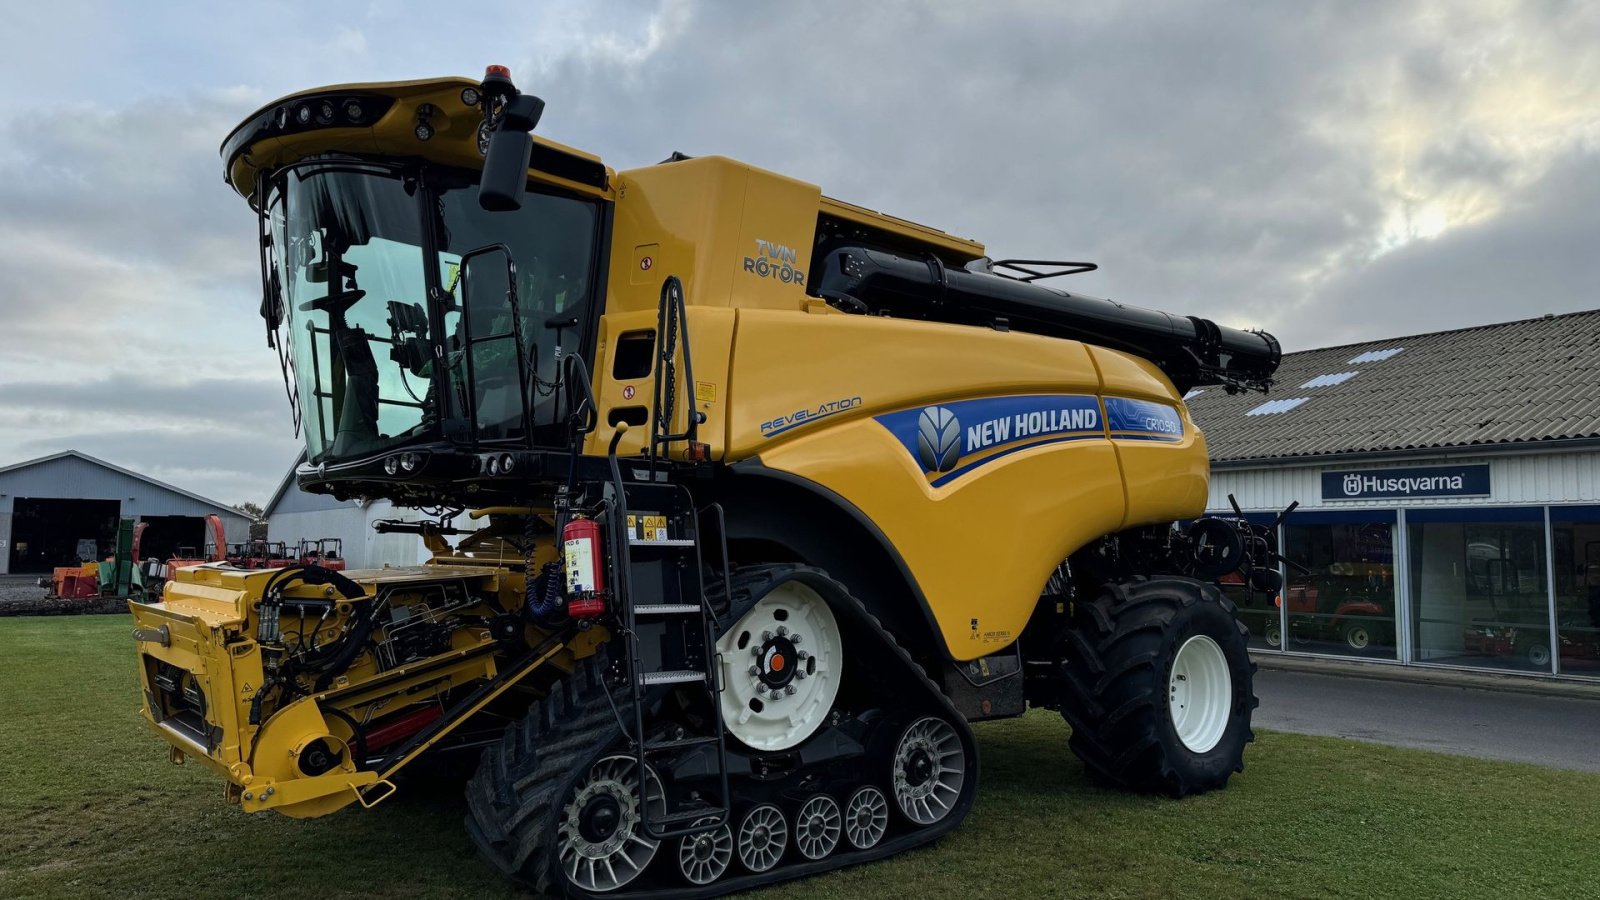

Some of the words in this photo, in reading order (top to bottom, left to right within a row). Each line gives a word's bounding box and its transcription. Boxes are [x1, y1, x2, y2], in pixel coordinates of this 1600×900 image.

[755, 239, 796, 264] TWIN
[744, 256, 805, 286] ROTOR
[760, 396, 862, 432] REVELATION
[1145, 417, 1176, 433] CR10.90
[967, 421, 1010, 452] NEW
[1015, 408, 1097, 436] HOLLAND
[1363, 474, 1463, 494] Husqvarna
